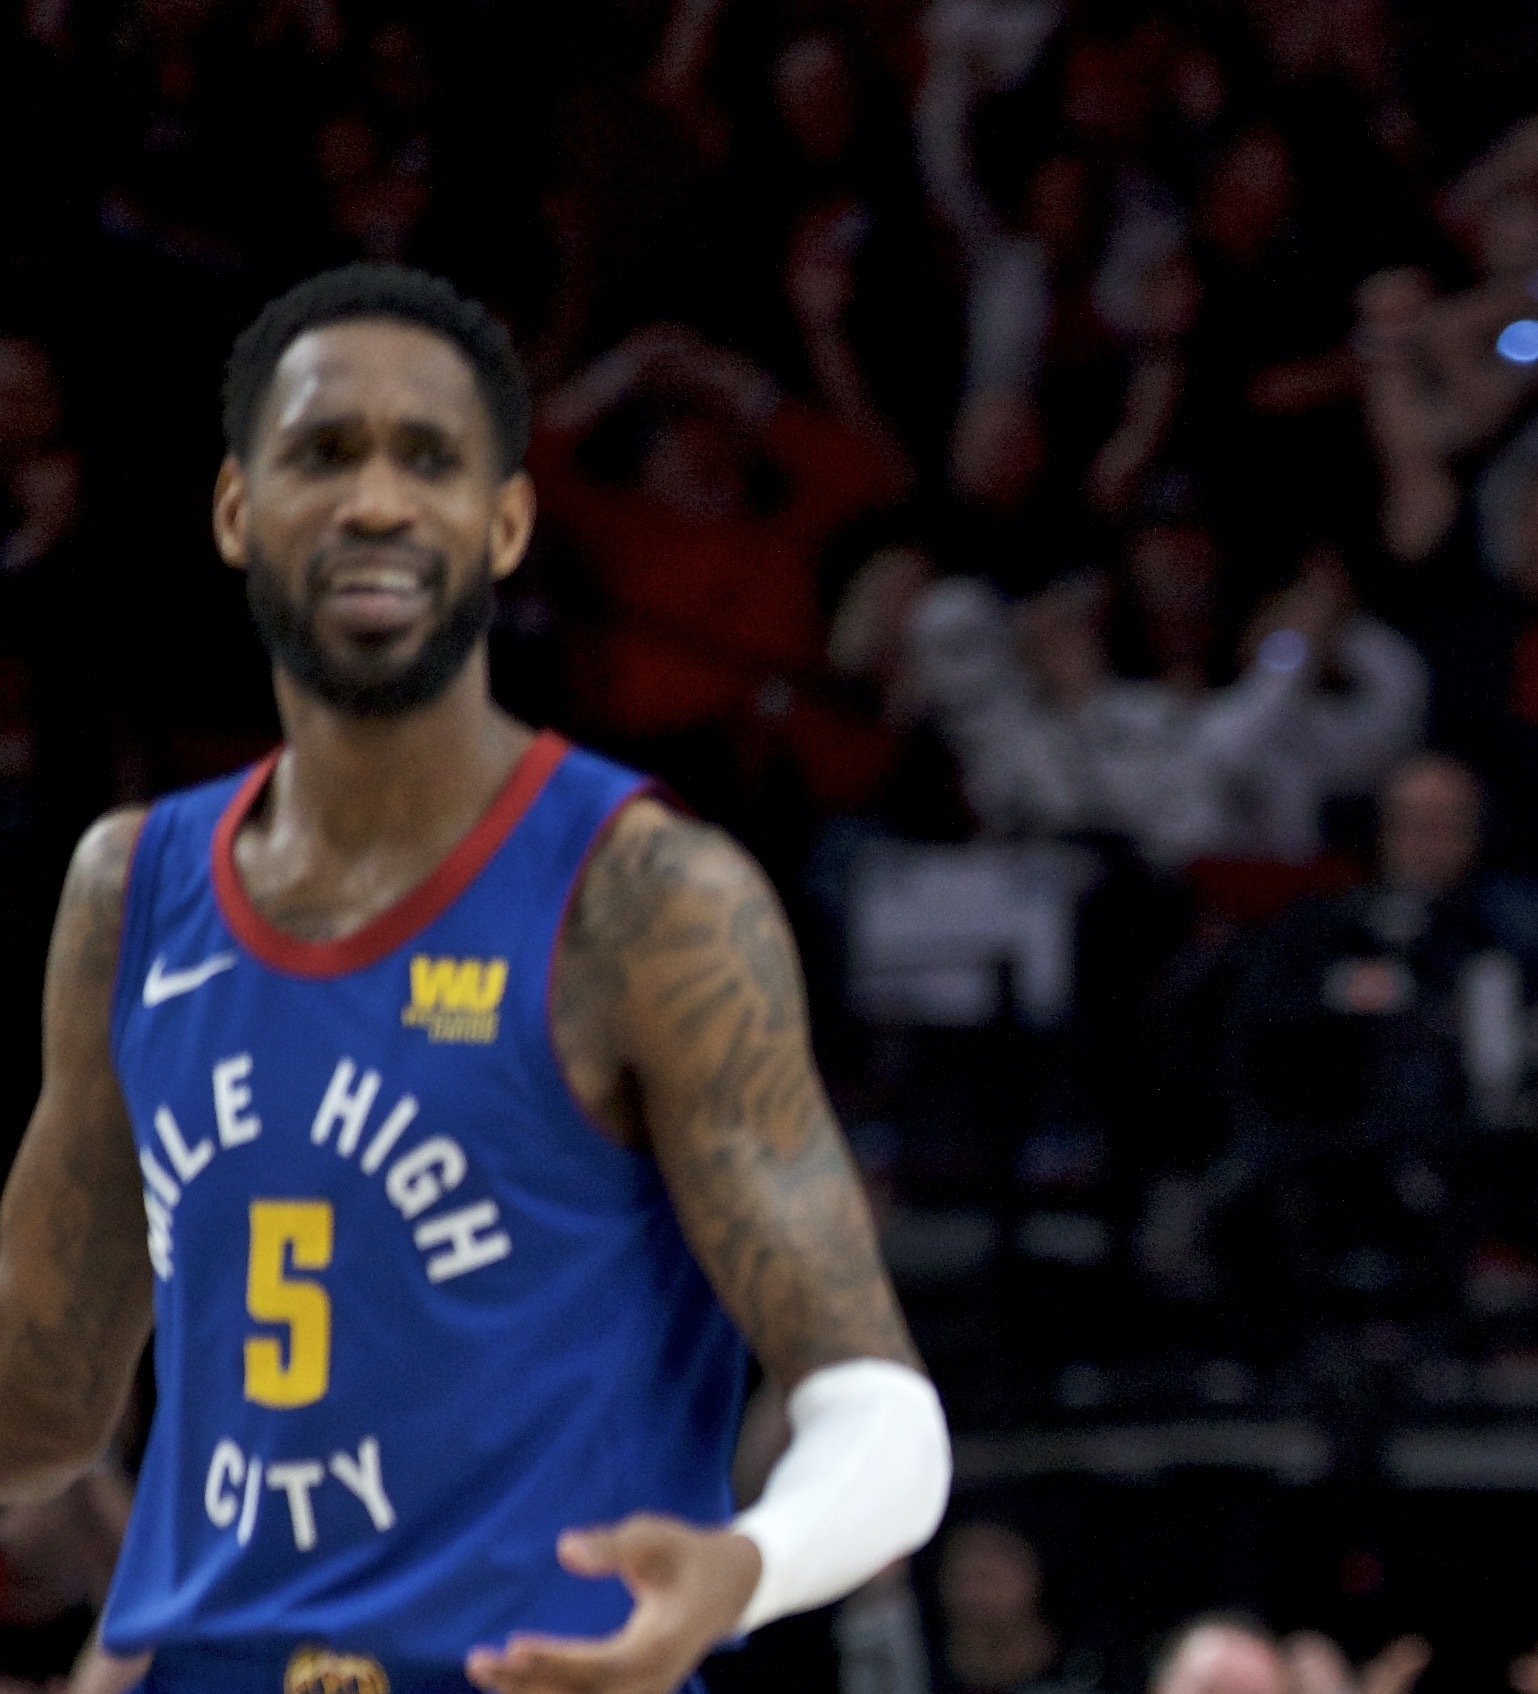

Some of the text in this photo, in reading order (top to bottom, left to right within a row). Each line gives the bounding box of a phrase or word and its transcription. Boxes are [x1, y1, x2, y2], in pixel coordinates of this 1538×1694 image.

[310, 1056, 513, 1285] HIGH
[244, 1199, 334, 1408] 5
[204, 1436, 396, 1552] CITY
